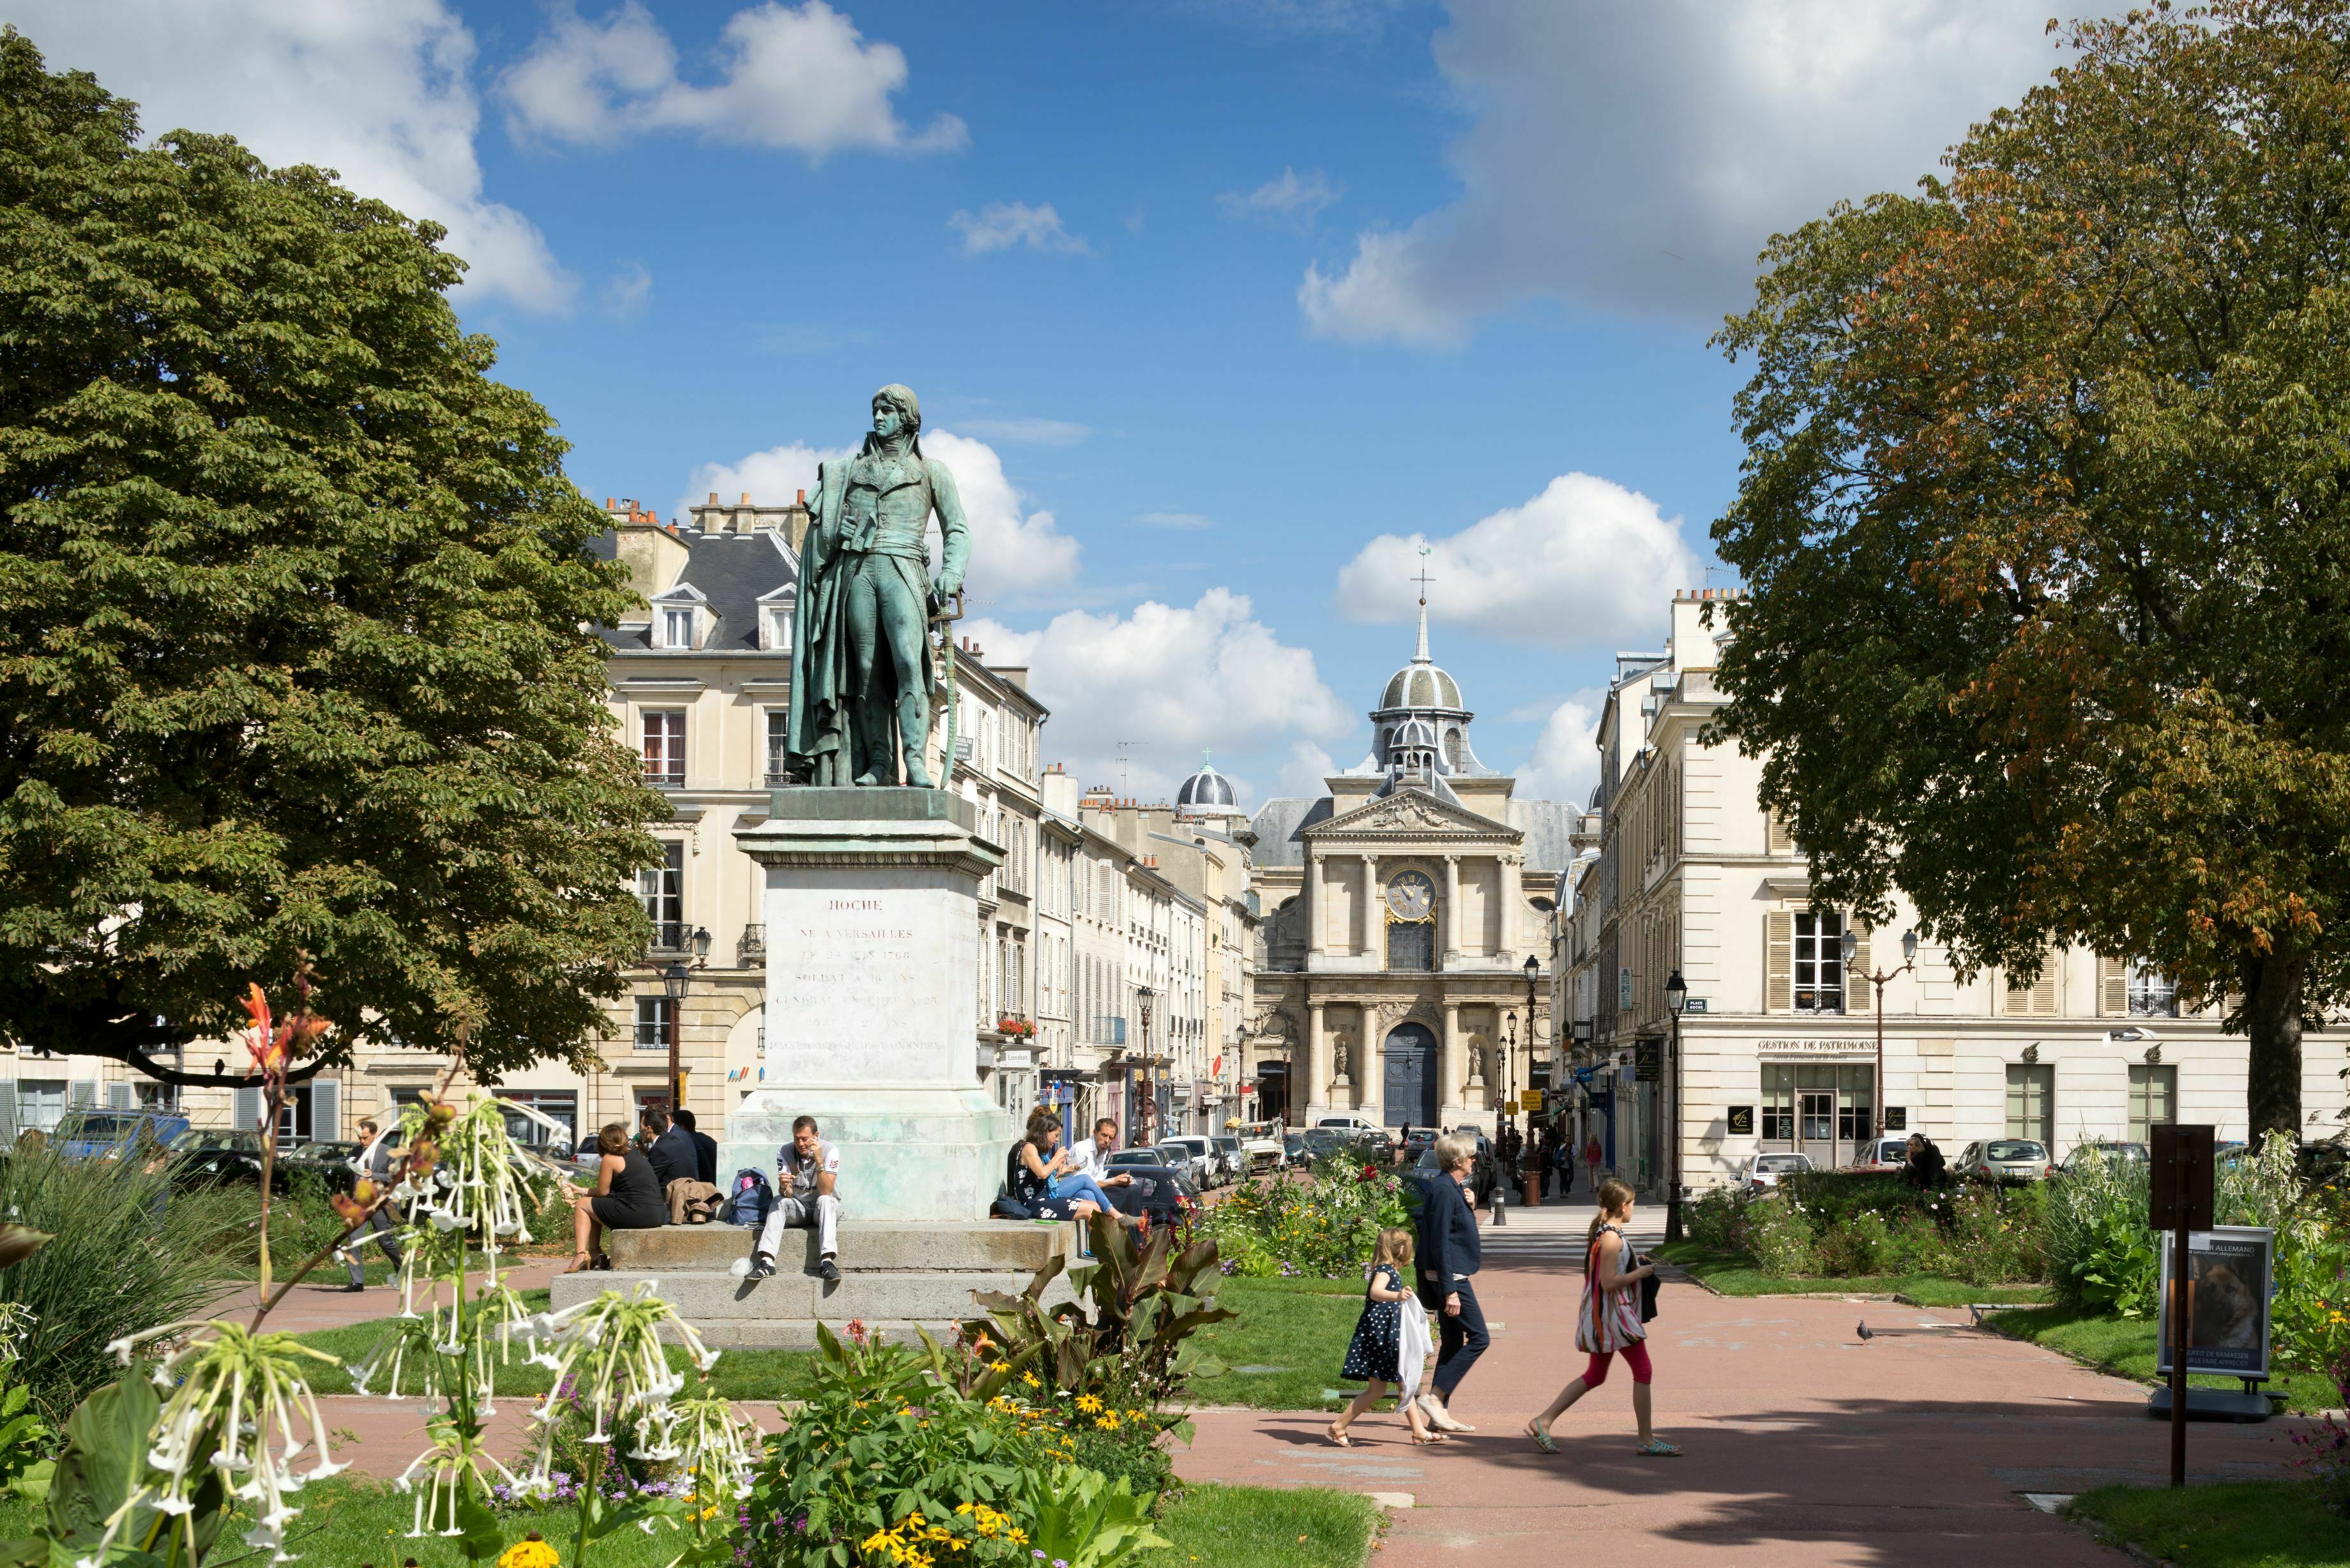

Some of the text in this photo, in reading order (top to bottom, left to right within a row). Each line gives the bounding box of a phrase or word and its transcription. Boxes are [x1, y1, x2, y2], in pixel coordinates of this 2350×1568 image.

[829, 900, 883, 910] HOCHE
[837, 930, 913, 939] VERSAILLES
[883, 951, 910, 960] 1768
[795, 974, 845, 982] SOLDAT
[1621, 969, 1630, 1009] ARMES
[1758, 1041, 1878, 1050] GESTION DE PATRIMOINE
